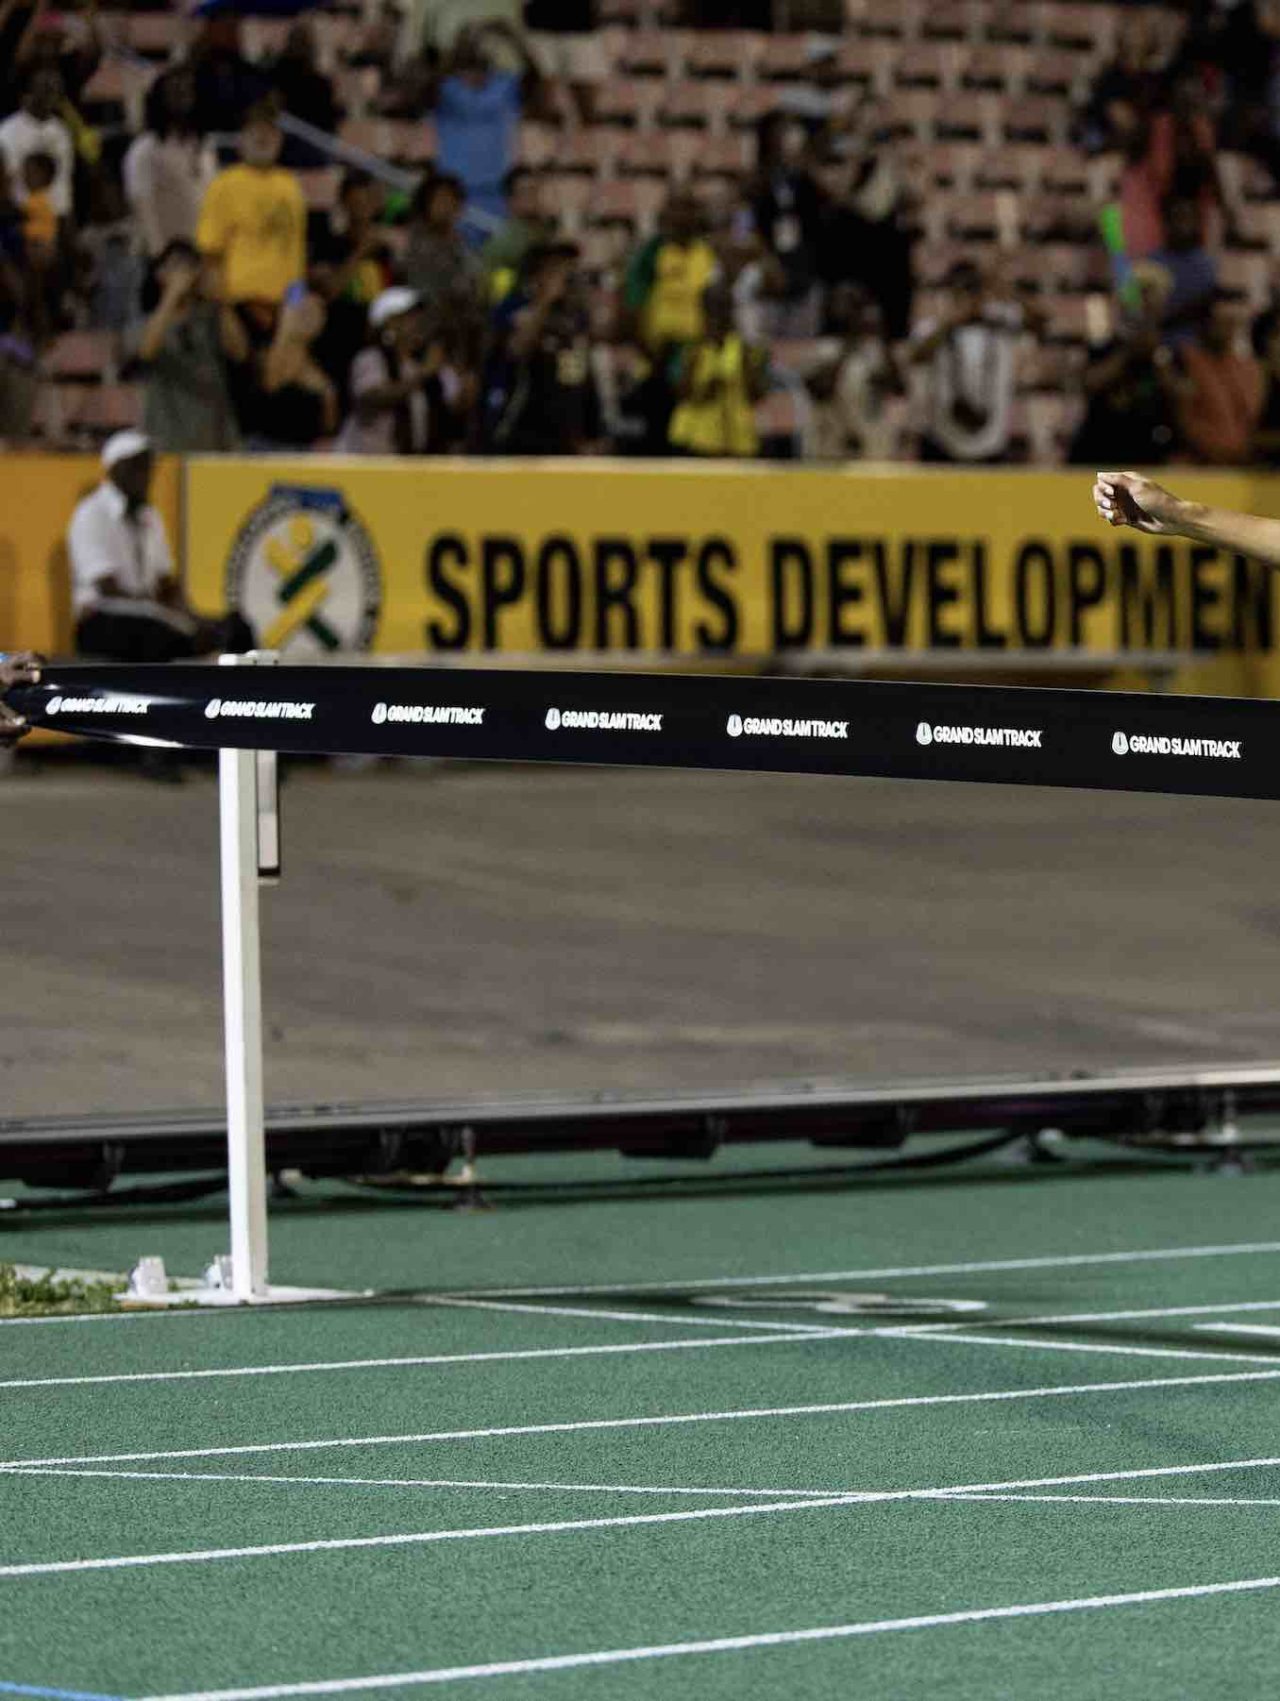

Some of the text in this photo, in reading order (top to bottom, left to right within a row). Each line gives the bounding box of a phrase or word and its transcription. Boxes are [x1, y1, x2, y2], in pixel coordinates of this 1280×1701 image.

[427, 530, 739, 652] SPORTS
[562, 711, 662, 731] GRAND SLAM TRACK
[744, 718, 848, 739] GRAND SLAM TRACK
[933, 726, 1041, 748] GRAND SLAM TRACK
[1130, 735, 1240, 758] GRAND SLAM TRACK
